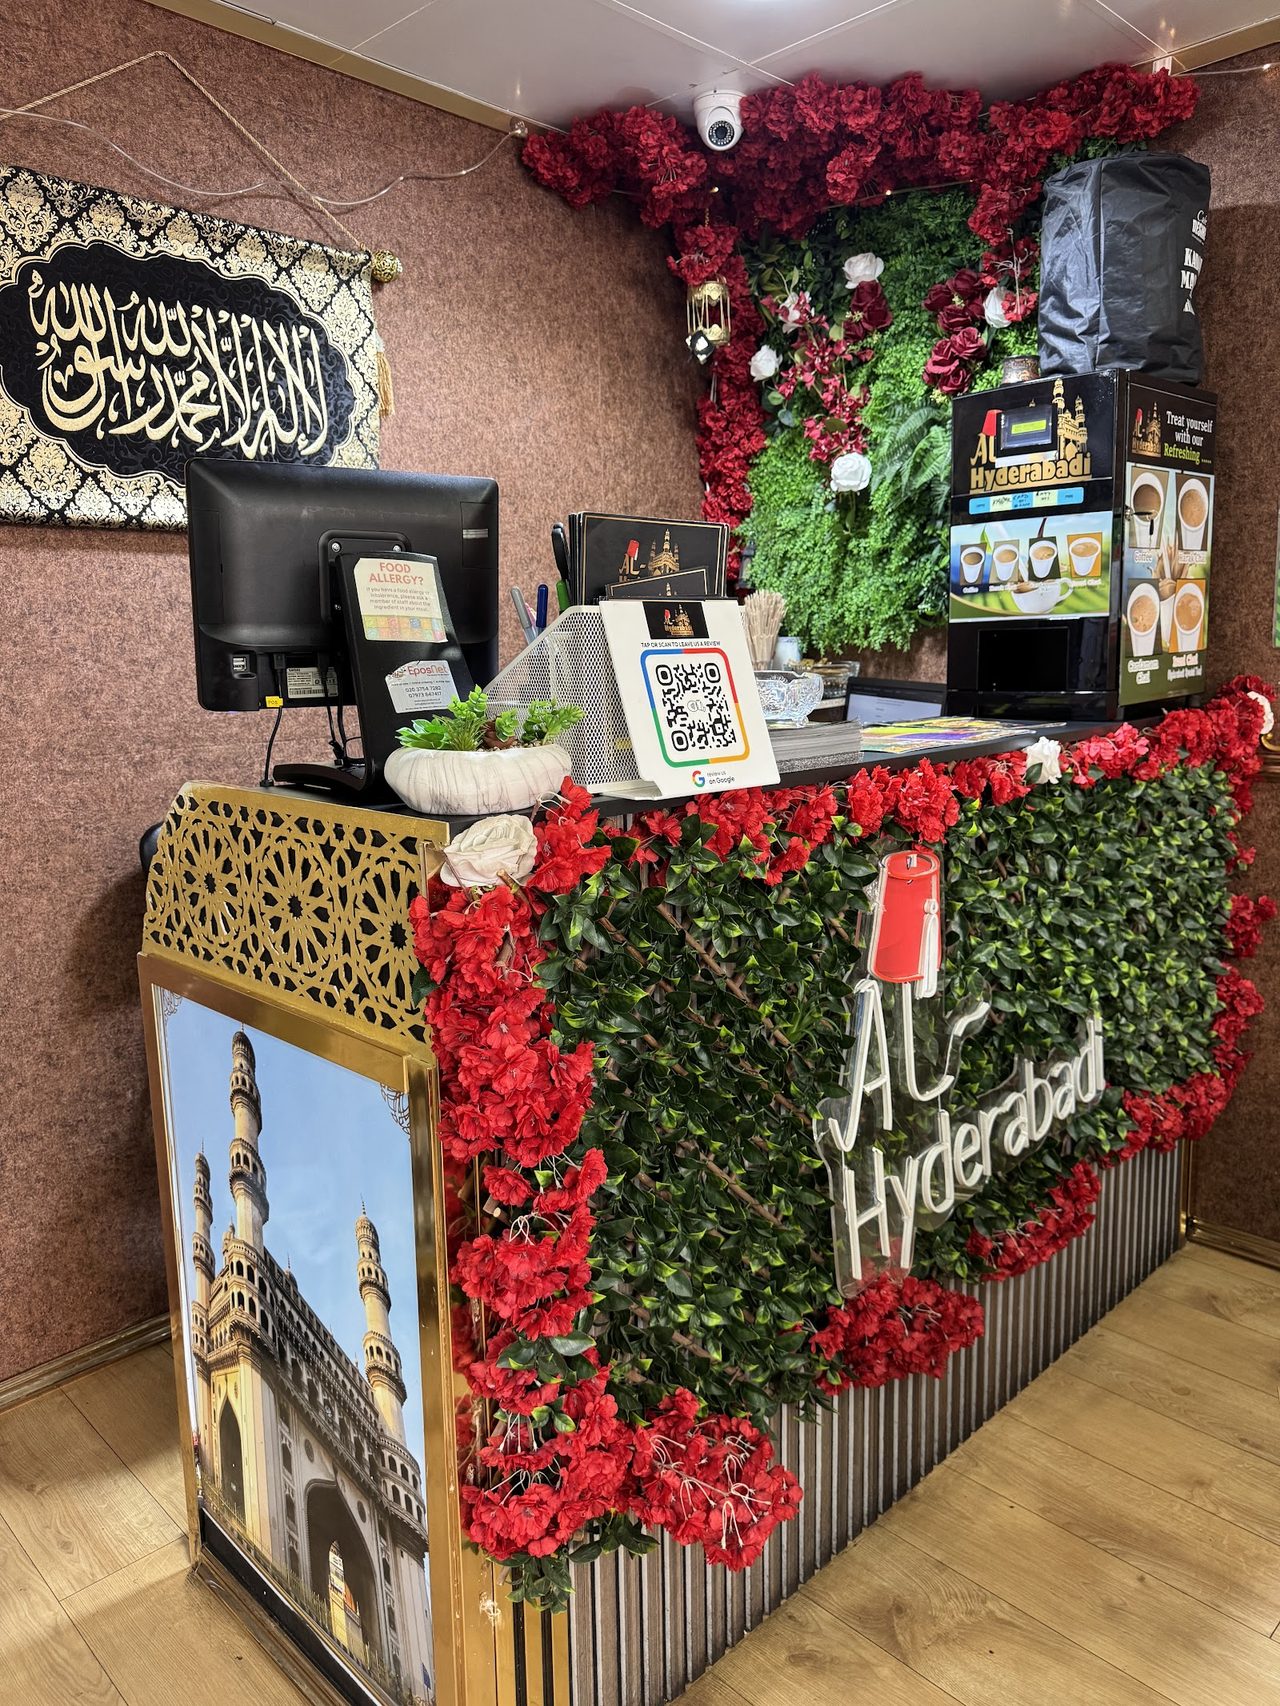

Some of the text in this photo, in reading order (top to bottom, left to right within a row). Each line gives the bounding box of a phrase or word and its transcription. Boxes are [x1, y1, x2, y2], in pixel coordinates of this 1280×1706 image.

[1166, 410, 1213, 433] Treat yourself
[1174, 430, 1204, 446] with our
[1163, 443, 1200, 465] Refreshing
[970, 452, 1092, 491] Hyderabadi
[379, 562, 411, 573] FOOD
[369, 573, 424, 585] ALLERGY?
[407, 665, 448, 676] EposNet
[716, 776, 735, 784] Google
[844, 1014, 1106, 1280] Hyderabadi
